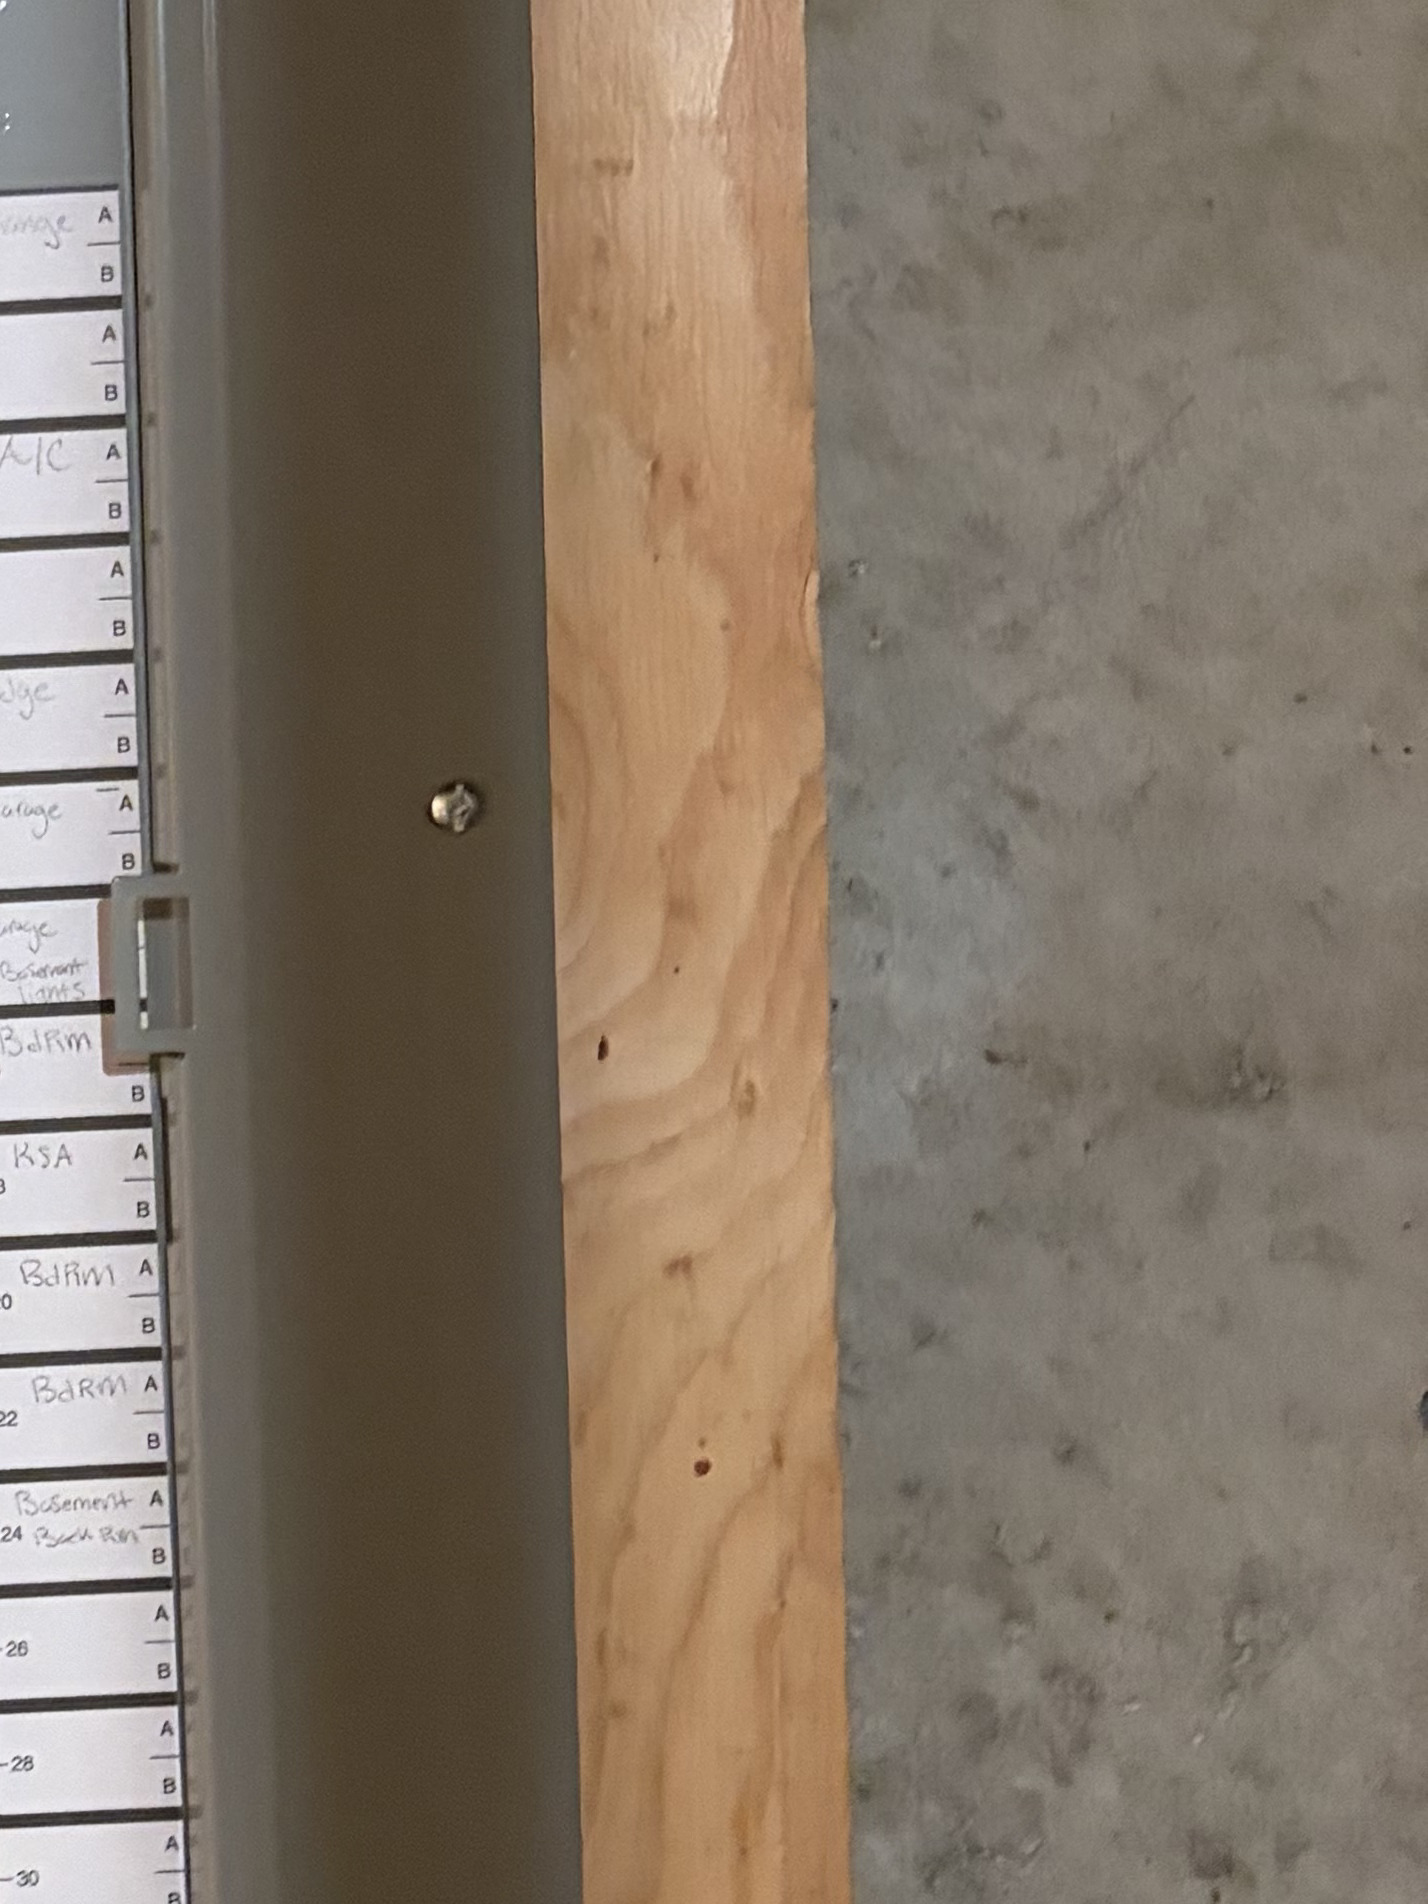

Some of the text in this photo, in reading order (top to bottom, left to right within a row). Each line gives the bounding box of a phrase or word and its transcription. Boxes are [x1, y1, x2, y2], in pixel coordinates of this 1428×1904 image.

[133, 1143, 148, 1160] A
[136, 1200, 151, 1219] B
[139, 1258, 153, 1276] A
[141, 1317, 156, 1334] B
[144, 1374, 158, 1392] A
[147, 1432, 161, 1450] B
[149, 1489, 164, 1507] A
[0, 1525, 22, 1542] 24
[151, 1547, 167, 1565] B
[154, 1604, 170, 1622] A
[5, 1640, 28, 1657] 26
[157, 1662, 172, 1680] B
[160, 1720, 174, 1737] A
[10, 1755, 34, 1772] 28
[162, 1777, 177, 1795] B
[165, 1835, 179, 1851] A
[15, 1869, 39, 1886] 30
